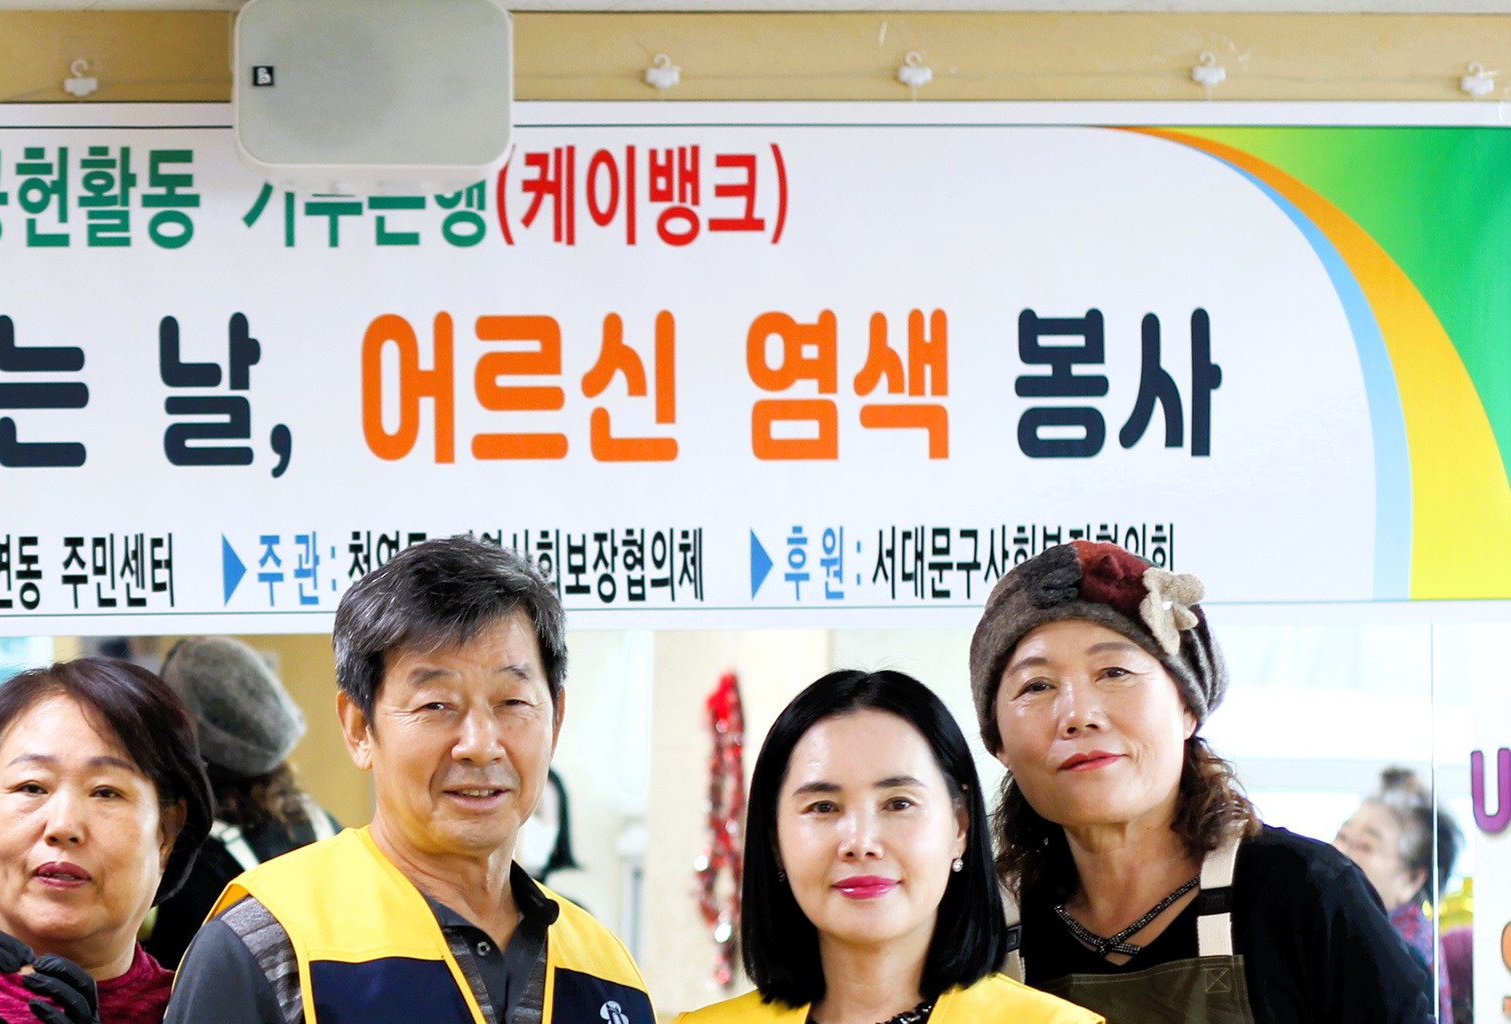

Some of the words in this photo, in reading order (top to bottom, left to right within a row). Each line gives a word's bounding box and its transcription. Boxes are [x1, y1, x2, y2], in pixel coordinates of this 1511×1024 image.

[159, 311, 293, 478] 날,
[361, 309, 679, 463] 어르신
[746, 308, 950, 461] 염색
[1014, 308, 1222, 459] 봉사
[61, 532, 175, 609] 주민센터
[451, 527, 704, 604] 회보장협의체
